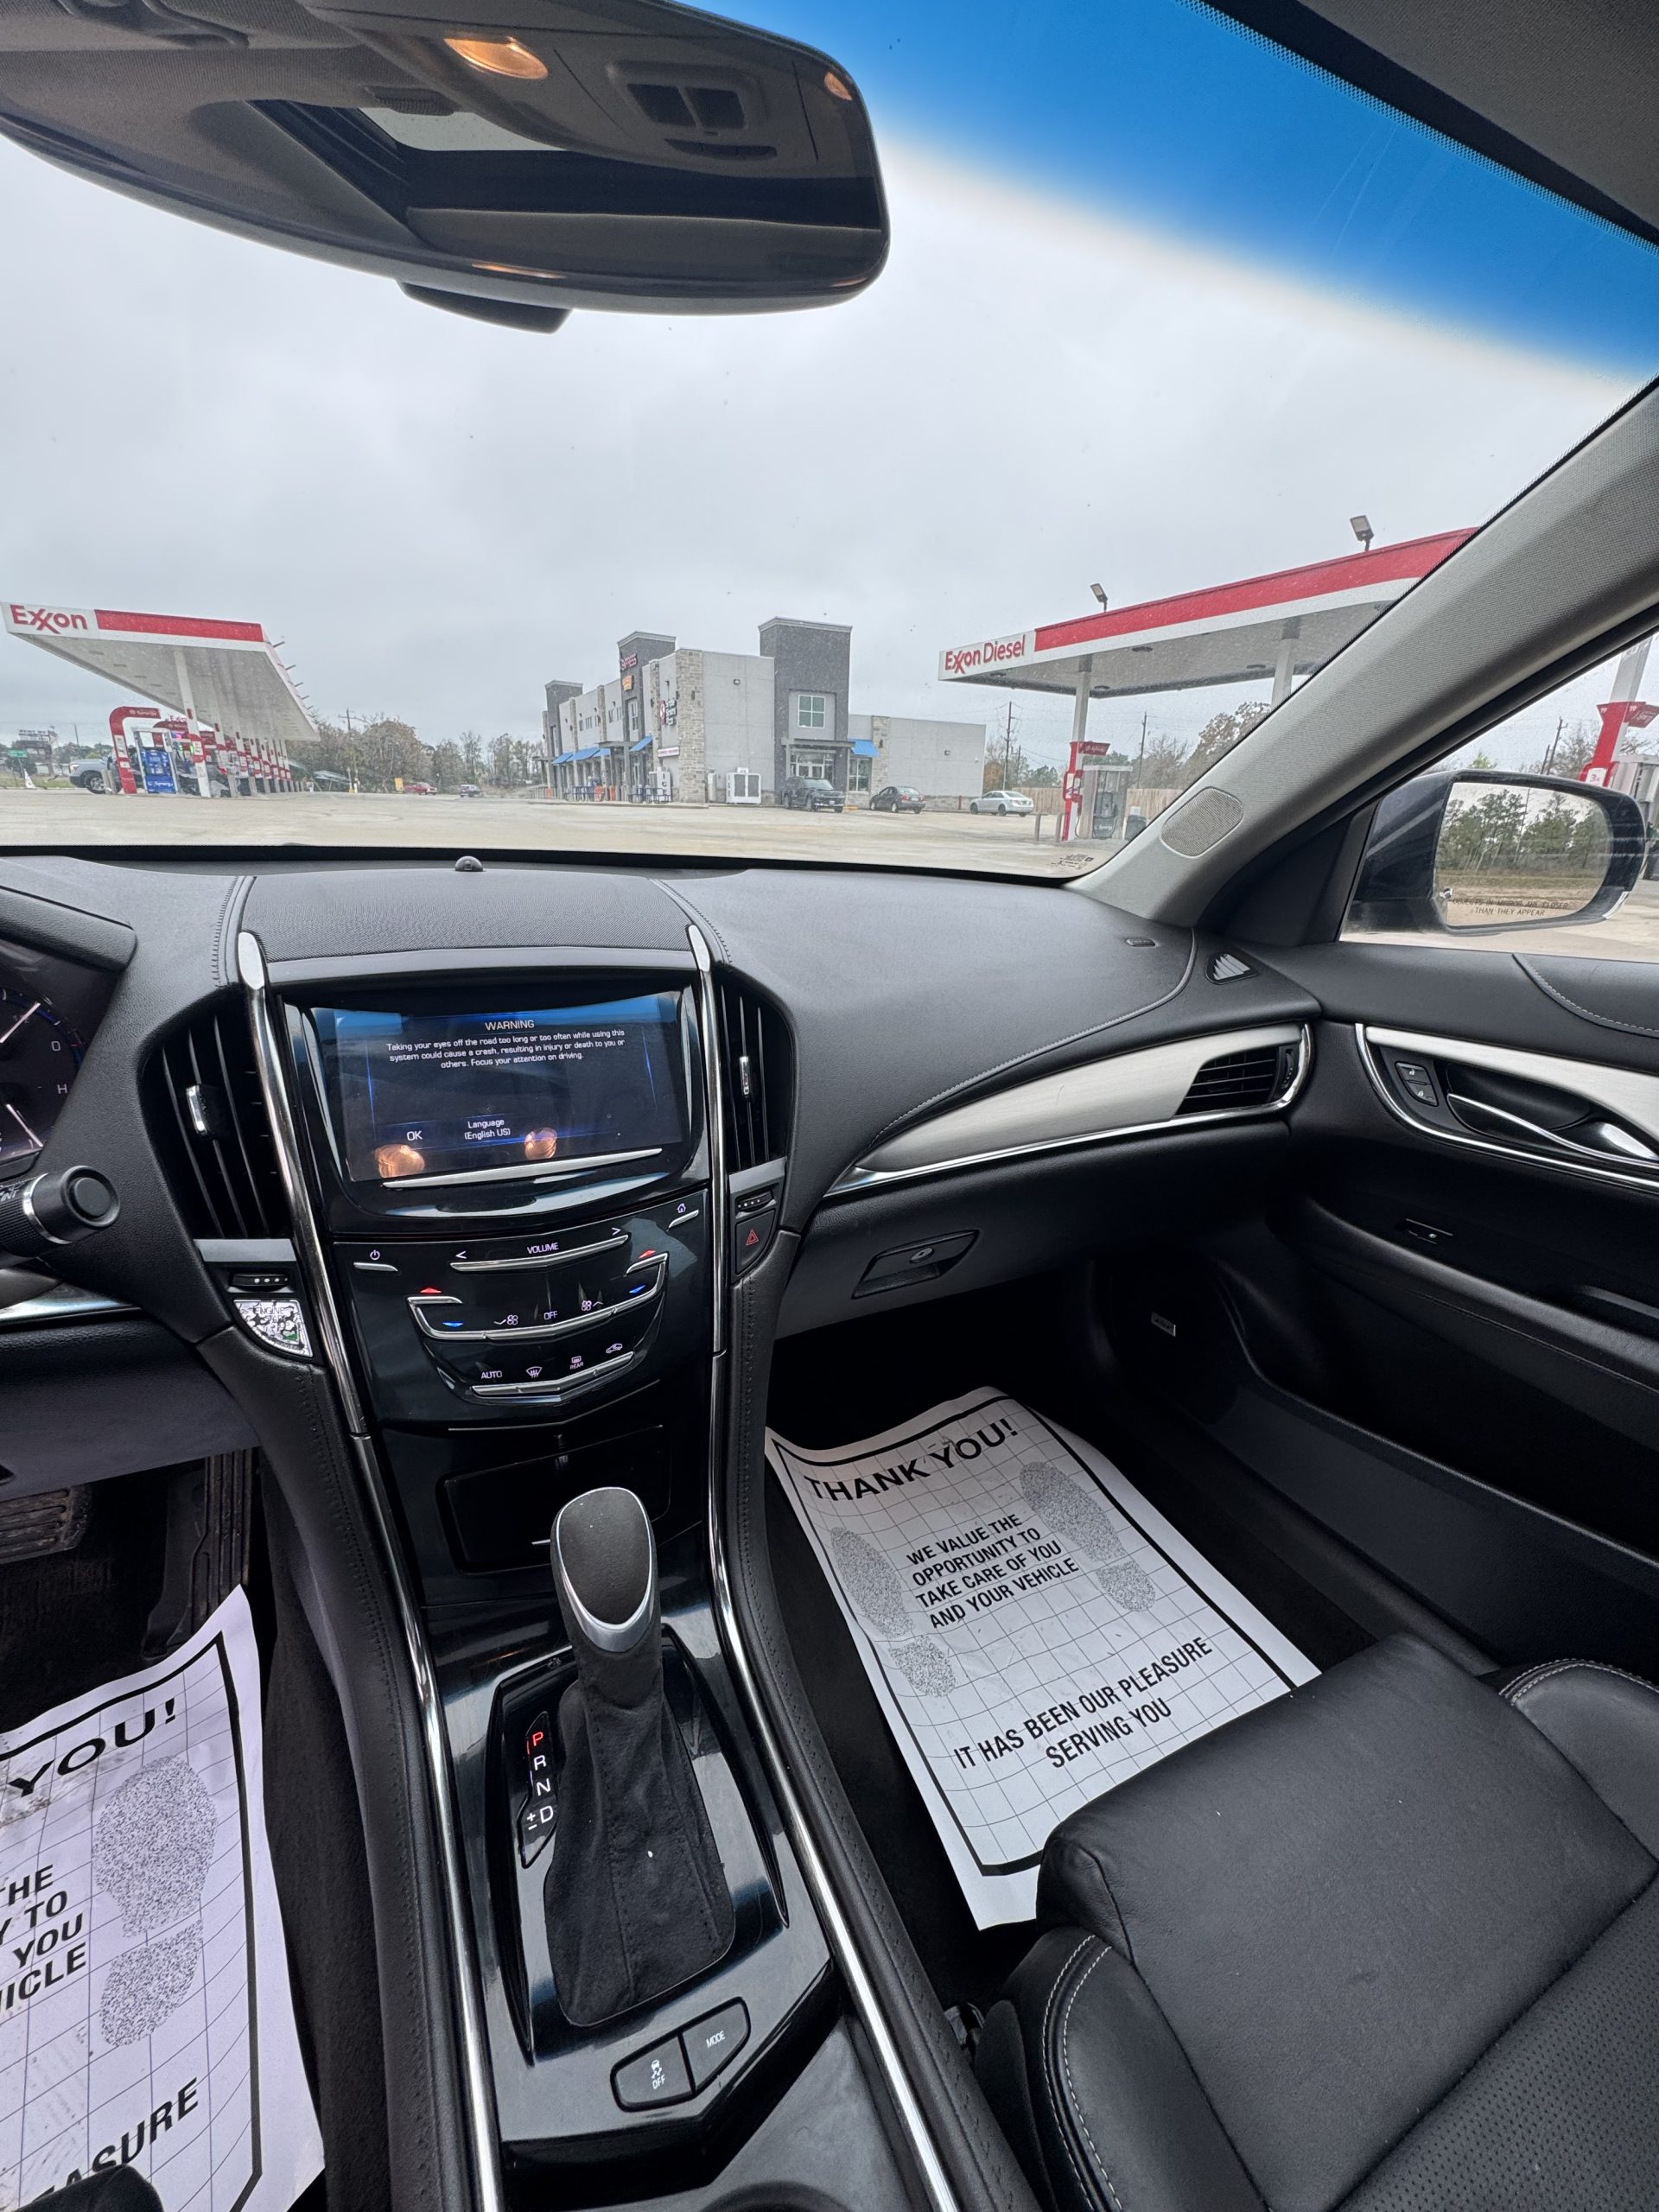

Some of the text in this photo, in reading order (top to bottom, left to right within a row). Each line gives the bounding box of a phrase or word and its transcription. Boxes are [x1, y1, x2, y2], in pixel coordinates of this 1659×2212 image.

[10, 604, 88, 634] Exxon
[944, 633, 1026, 674] Exxon Diesel
[485, 1020, 535, 1031] WARNING
[386, 1043, 413, 1052] Taking
[512, 1035, 528, 1044] long
[390, 1053, 419, 1063] system
[475, 1047, 499, 1056] crash,
[501, 1045, 533, 1054] resulting
[543, 1043, 563, 1052] injury
[441, 1059, 469, 1069] others.
[495, 1057, 512, 1066] your
[513, 1055, 547, 1064] attention
[558, 1052, 584, 1060] driving.
[57, 1083, 68, 1095] H
[467, 1119, 505, 1128] Language
[406, 1130, 423, 1141] OK
[464, 1128, 512, 1141] (English US)
[526, 1242, 559, 1255] VOLUME
[255, 1306, 284, 1315] ENGINE
[543, 1310, 558, 1321] OFF
[569, 1361, 584, 1370] REAR
[480, 1370, 503, 1380] AUTO
[804, 1418, 1018, 1502] THANK YOU!
[906, 1514, 1022, 1567] WE VALUE THE
[912, 1528, 1040, 1586] OPPORTUNITY TO
[915, 1540, 1062, 1609] TAKE CARE OF YOU
[929, 1557, 1079, 1629] AND YOUR VEHICLE
[953, 1637, 1213, 1770] IT HAS BEEN OUR PLEASURE
[532, 1732, 544, 1747] P
[1046, 1697, 1172, 1769] SERVING YOU
[7, 1697, 176, 1798] YOU!
[533, 1755, 547, 1771] R
[536, 1778, 551, 1796] N
[0, 1864, 53, 1906] HE
[23, 1891, 68, 1929] TO
[12, 1912, 84, 1968] YOU
[0, 1942, 86, 2011] ICLE
[705, 2031, 726, 2049] MODE
[652, 2074, 666, 2090] OFF
